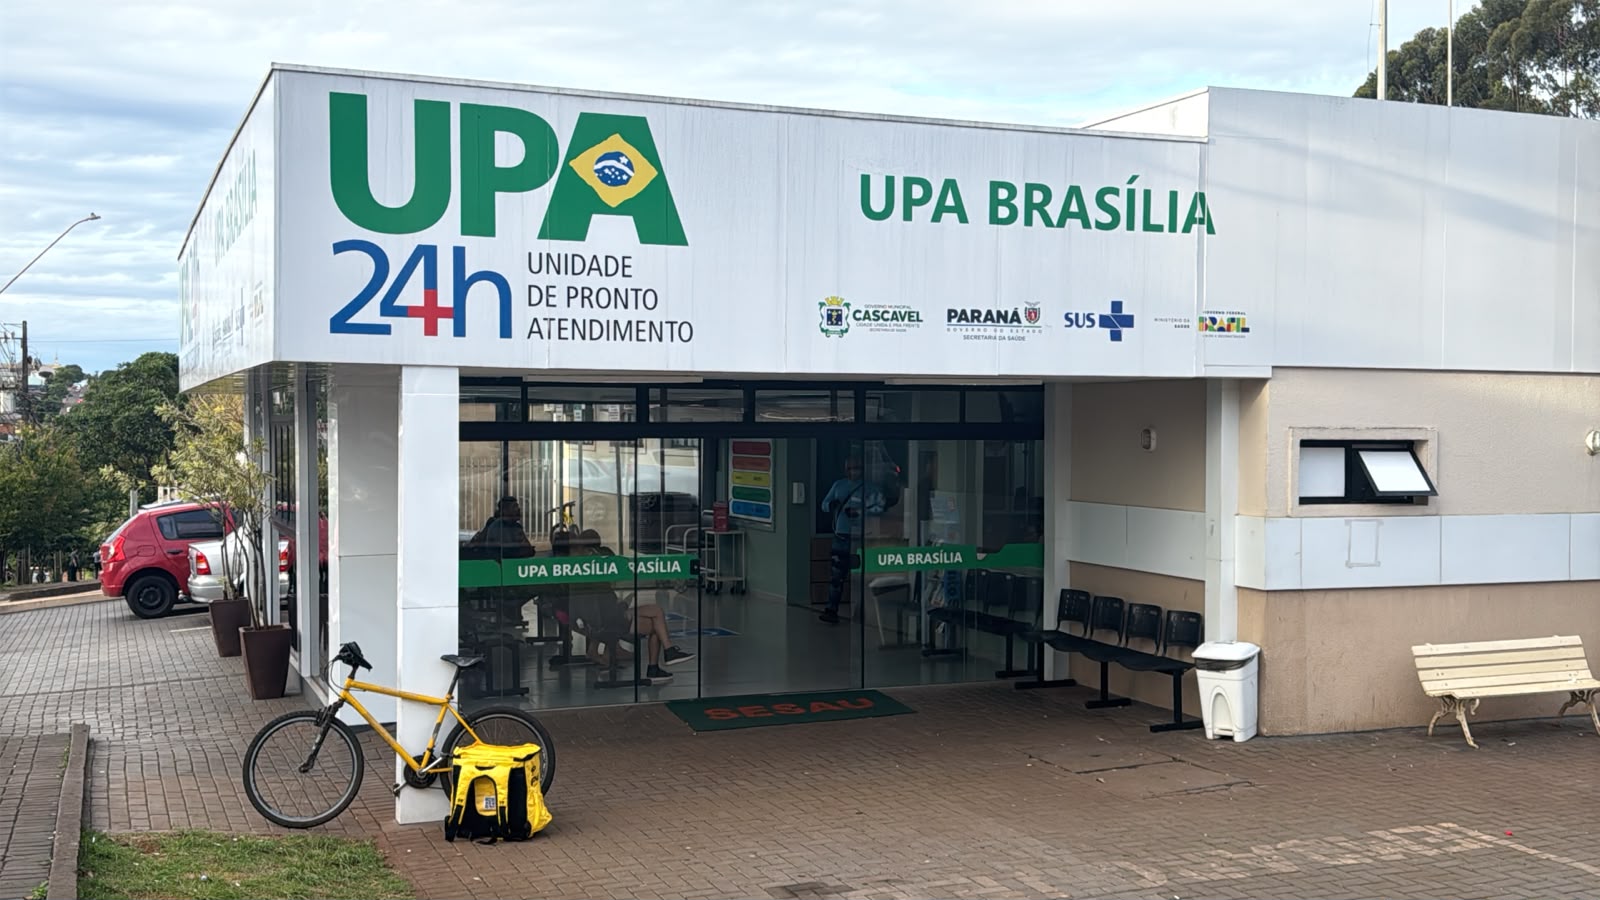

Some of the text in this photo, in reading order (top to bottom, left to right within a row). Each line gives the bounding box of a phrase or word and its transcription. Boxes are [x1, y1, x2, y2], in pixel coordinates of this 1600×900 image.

[329, 91, 689, 246] UPA
[860, 174, 1217, 235] UPA BRASÍLIA
[527, 252, 632, 279] UNIDADE
[329, 239, 512, 339] 24h
[527, 285, 658, 311] DE PRONTO
[852, 309, 924, 323] CASCAVEL
[947, 307, 1022, 324] PARANÁ
[1064, 312, 1096, 328] SUS
[1198, 316, 1250, 333] BRASIL
[527, 317, 693, 343] ATENDIMENTO
[628, 558, 682, 574] RASÍLIA
[878, 549, 963, 566] UPA BRASÍLIA
[518, 559, 618, 578] UPA BRASÍLIA
[704, 698, 875, 720] SESAU
